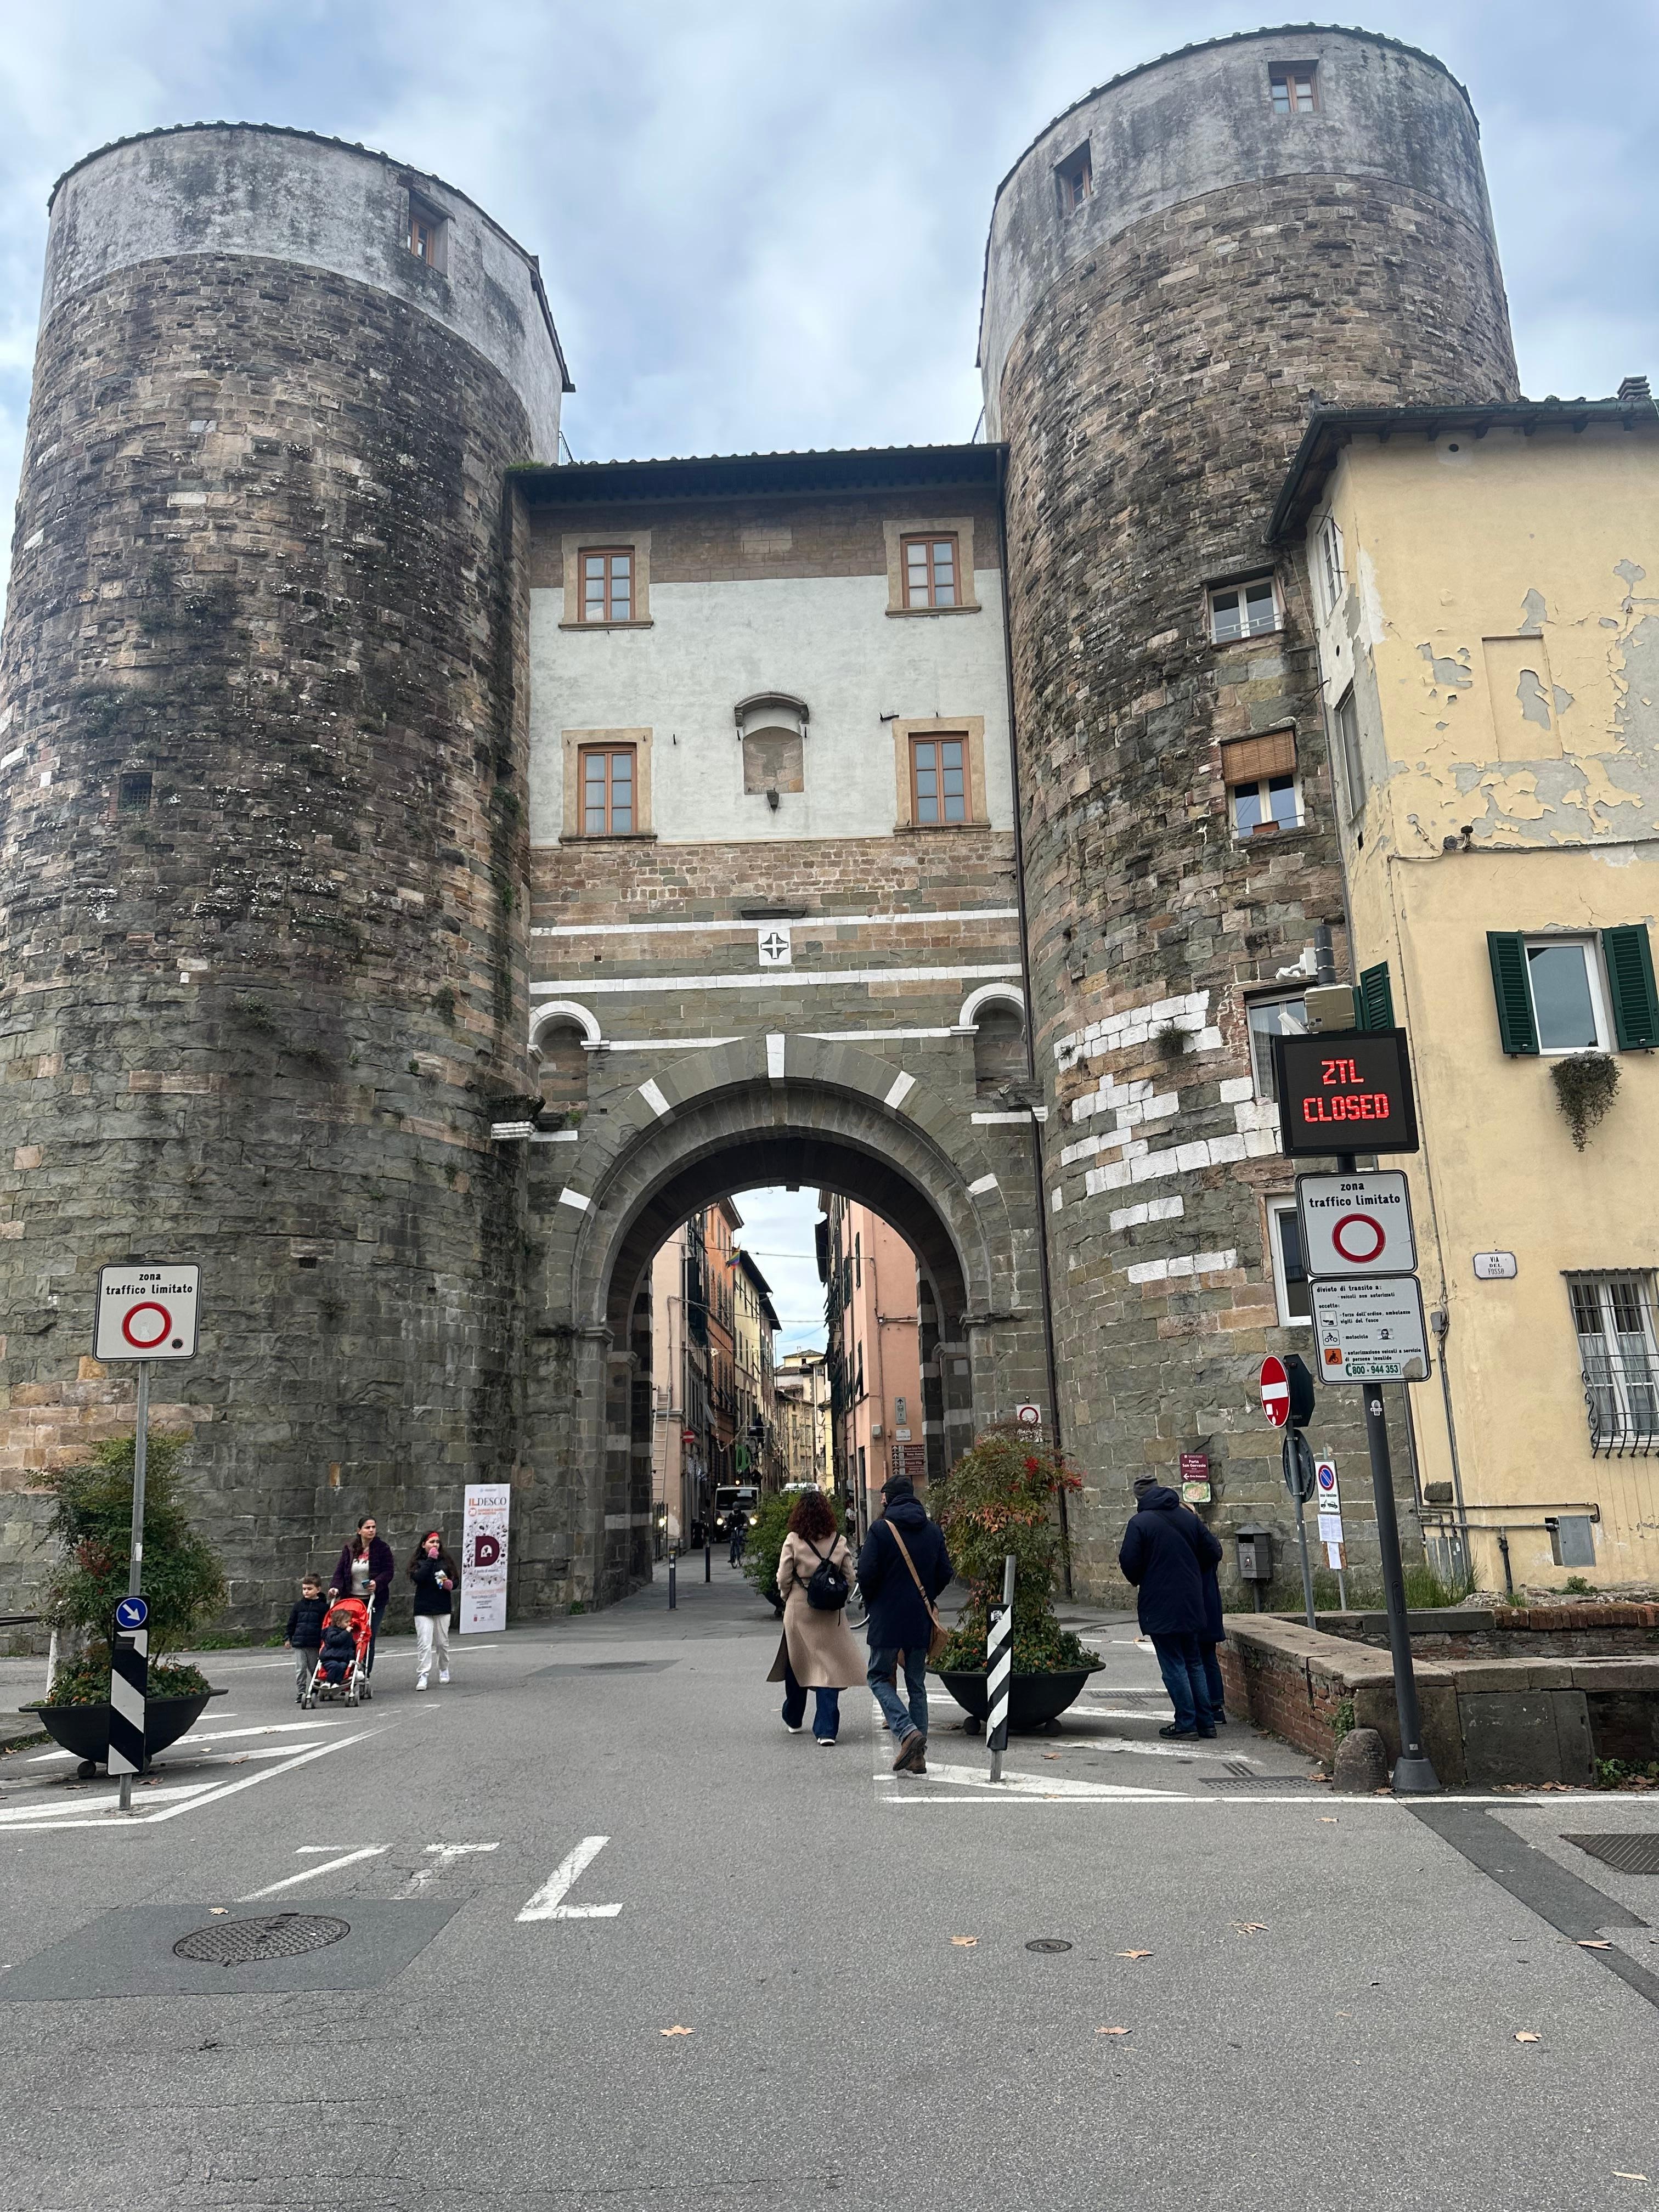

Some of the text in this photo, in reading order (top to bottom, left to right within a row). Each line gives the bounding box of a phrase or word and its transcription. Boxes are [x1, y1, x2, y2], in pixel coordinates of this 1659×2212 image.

[1321, 1059, 1364, 1085] ZTL
[1303, 1093, 1390, 1122] CLOSED
[1340, 1182, 1364, 1191] zona
[1309, 1194, 1401, 1207] traffico limitato
[106, 1284, 193, 1295] traffico limitato
[1352, 1365, 1365, 1374] 800
[1371, 1365, 1384, 1374] 944
[1385, 1364, 1398, 1373] 353
